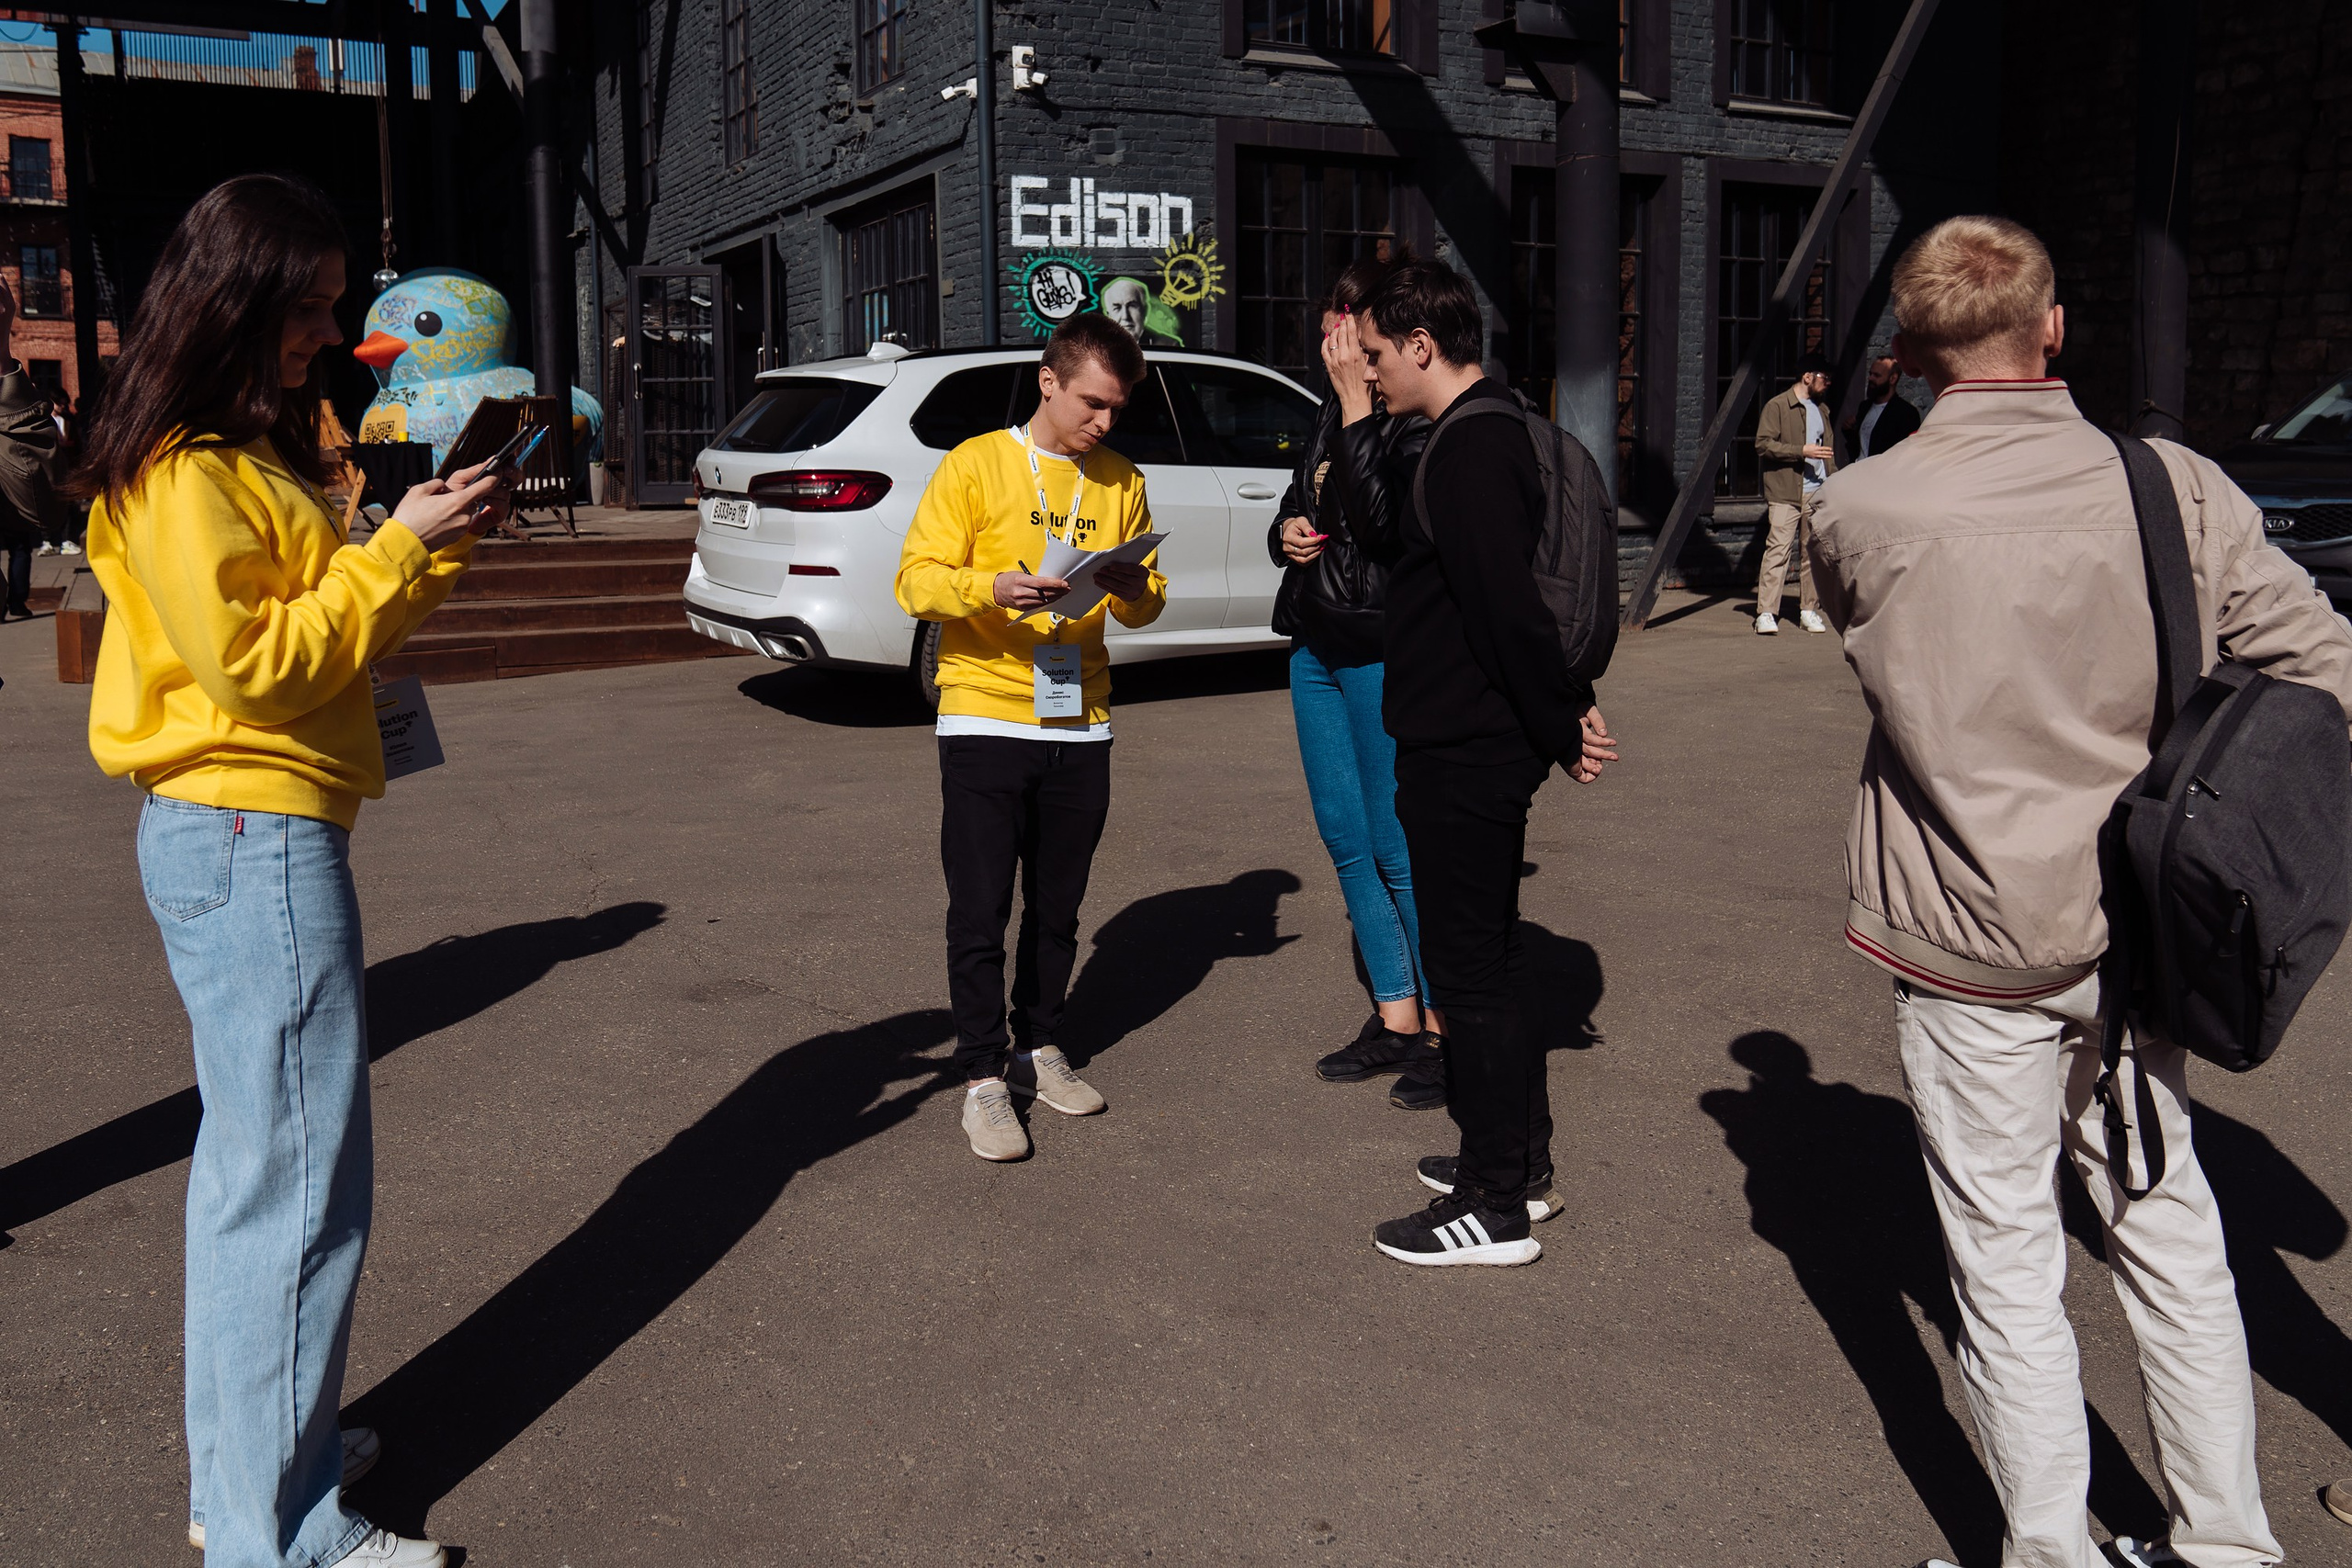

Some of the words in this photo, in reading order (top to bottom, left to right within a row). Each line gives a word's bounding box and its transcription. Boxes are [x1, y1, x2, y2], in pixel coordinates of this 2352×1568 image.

[1011, 175, 1193, 248] Edison
[1030, 511, 1096, 531] Sluton
[2265, 519, 2285, 528] KIA
[1050, 678, 1066, 686] Cup
[378, 710, 418, 728] lution
[380, 725, 407, 739] Cup
